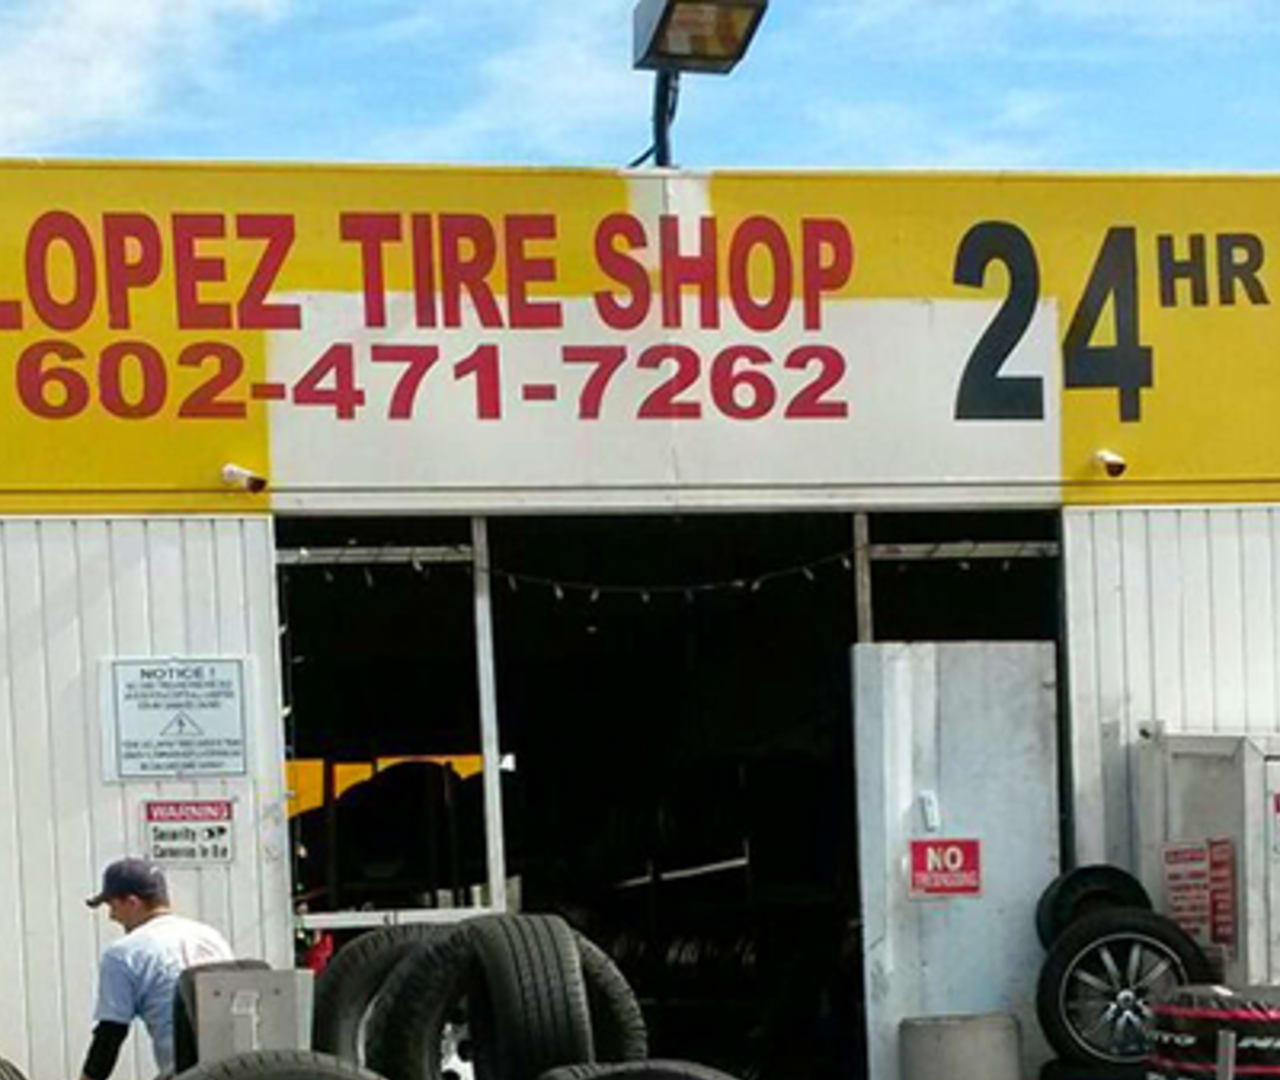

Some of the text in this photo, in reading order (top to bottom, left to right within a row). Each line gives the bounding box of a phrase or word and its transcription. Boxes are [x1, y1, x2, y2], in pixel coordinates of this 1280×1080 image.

[339, 212, 565, 331] TIRE
[593, 213, 854, 332] SHOP
[953, 220, 1269, 423] 24 HR
[14, 339, 850, 422] 602-471-7262
[140, 668, 203, 680] NOTICE
[150, 806, 228, 820] WARNING
[152, 825, 196, 843] Security
[926, 845, 965, 872] NO
